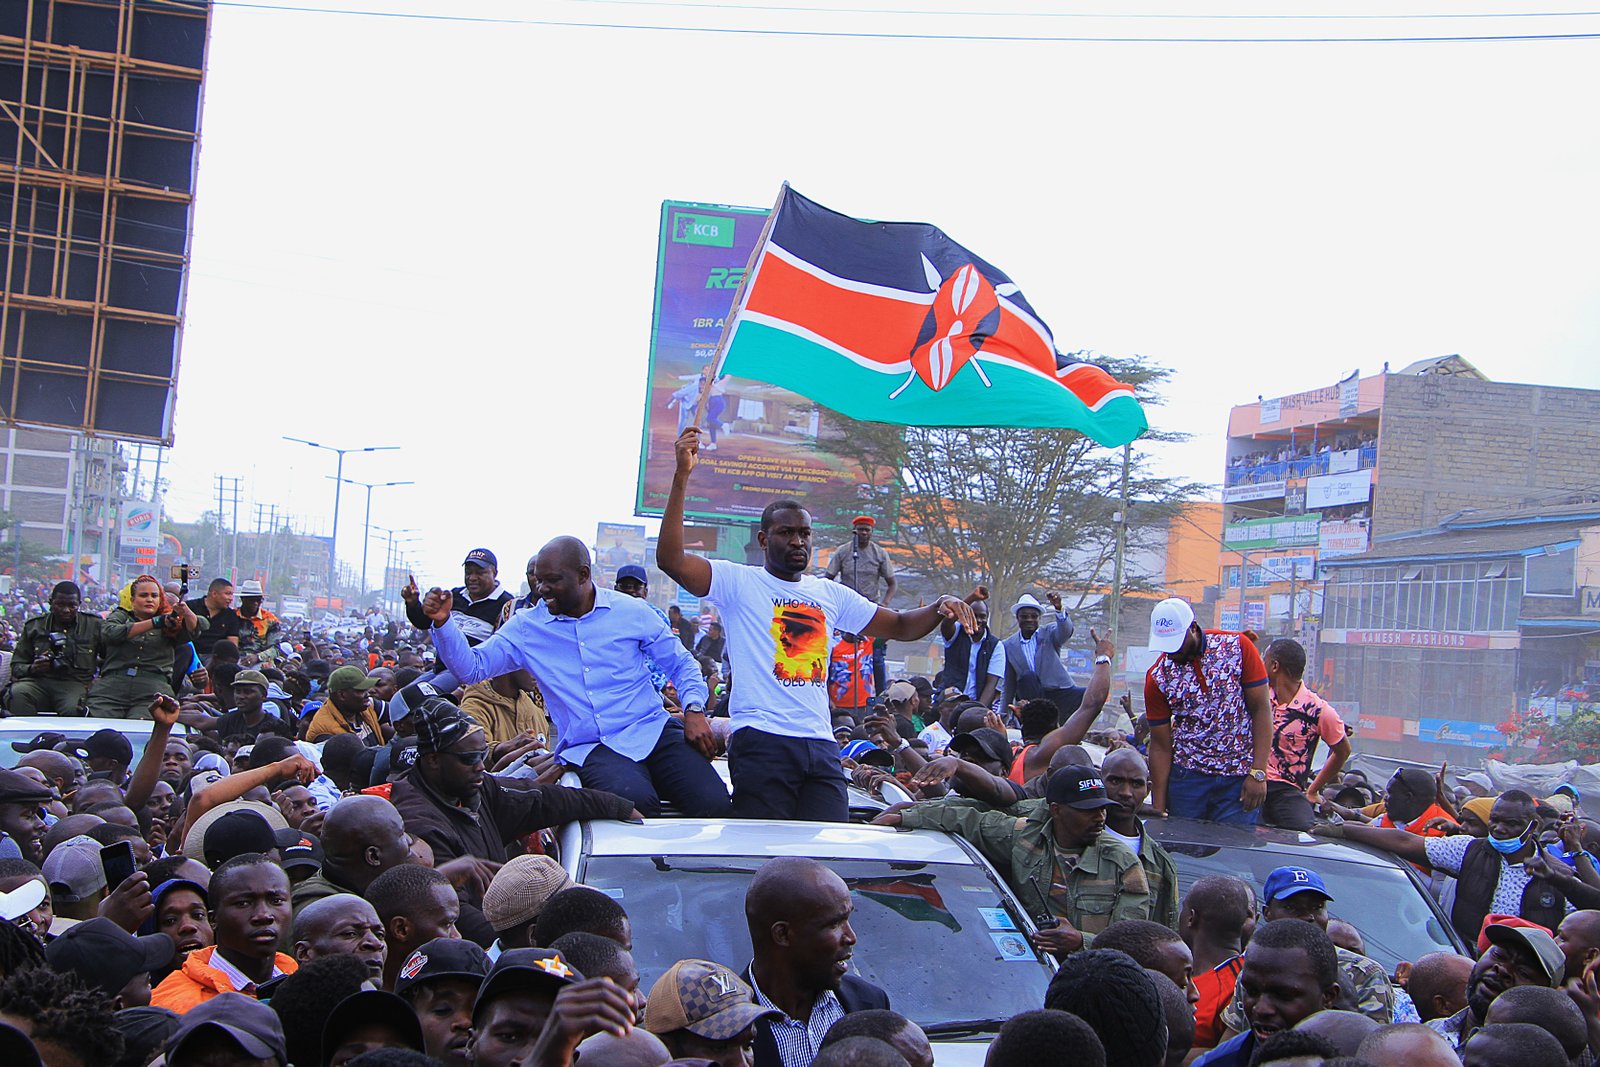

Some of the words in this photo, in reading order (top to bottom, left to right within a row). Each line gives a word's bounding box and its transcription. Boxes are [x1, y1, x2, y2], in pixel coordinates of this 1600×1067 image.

[694, 223, 719, 237] KCB
[693, 317, 714, 328] 1BR
[1326, 386, 1340, 401] HUB
[748, 463, 780, 471] ACCOUNT
[771, 598, 800, 609] WHO
[1410, 633, 1466, 646] FASHIONS
[777, 677, 805, 688] TOLD
[1291, 870, 1309, 882] E
